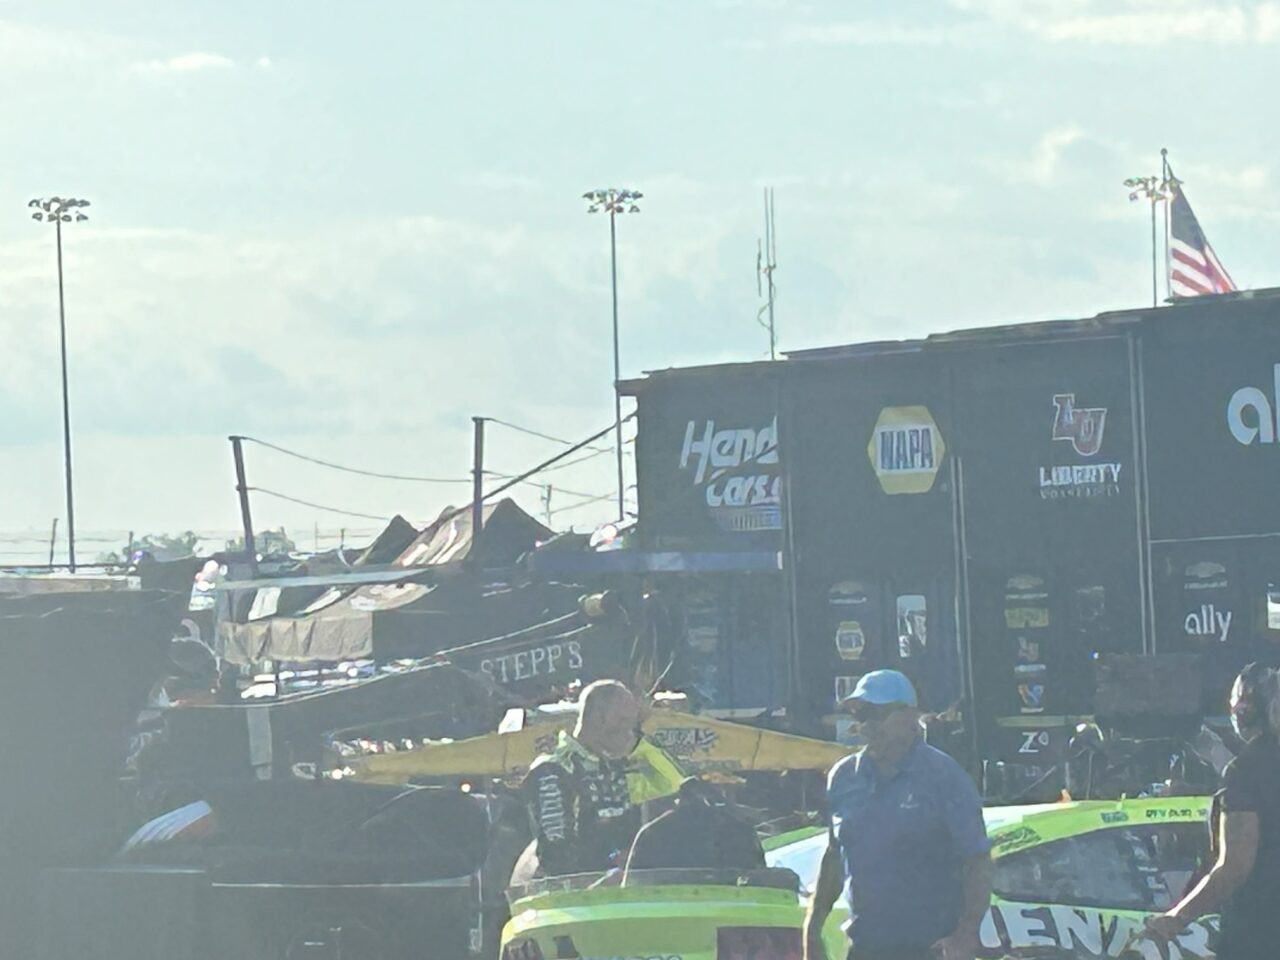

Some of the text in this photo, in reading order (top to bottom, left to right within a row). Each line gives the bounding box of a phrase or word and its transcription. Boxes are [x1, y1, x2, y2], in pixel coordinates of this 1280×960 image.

[880, 428, 935, 471] NAPA
[1040, 462, 1121, 486] LIBERTY
[1184, 604, 1232, 642] ally
[480, 640, 584, 684] STEPP'S
